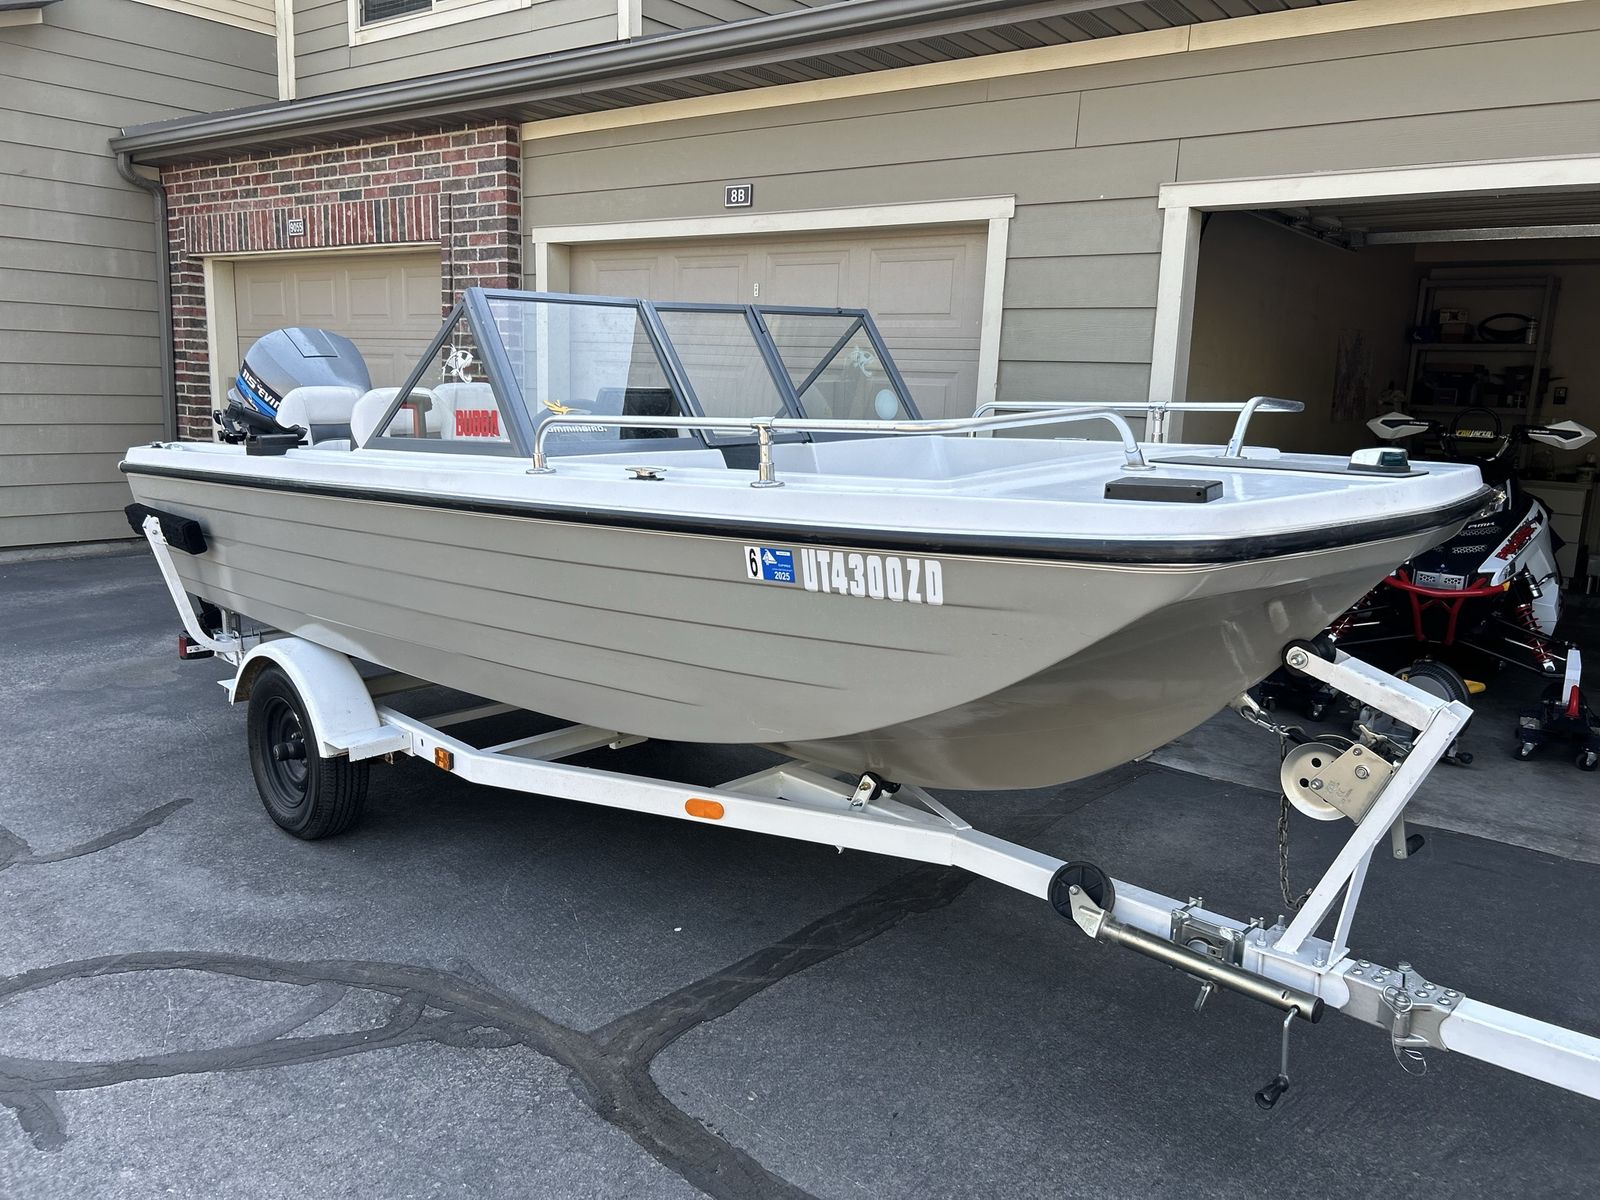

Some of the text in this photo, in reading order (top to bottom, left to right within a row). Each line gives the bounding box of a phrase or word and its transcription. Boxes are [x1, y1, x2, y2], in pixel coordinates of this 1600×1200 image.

[730, 189, 745, 203] 8B
[257, 384, 281, 410] EVIN
[749, 548, 758, 577] 6
[774, 571, 791, 581] 2025
[801, 548, 944, 606] UT4300ZD
